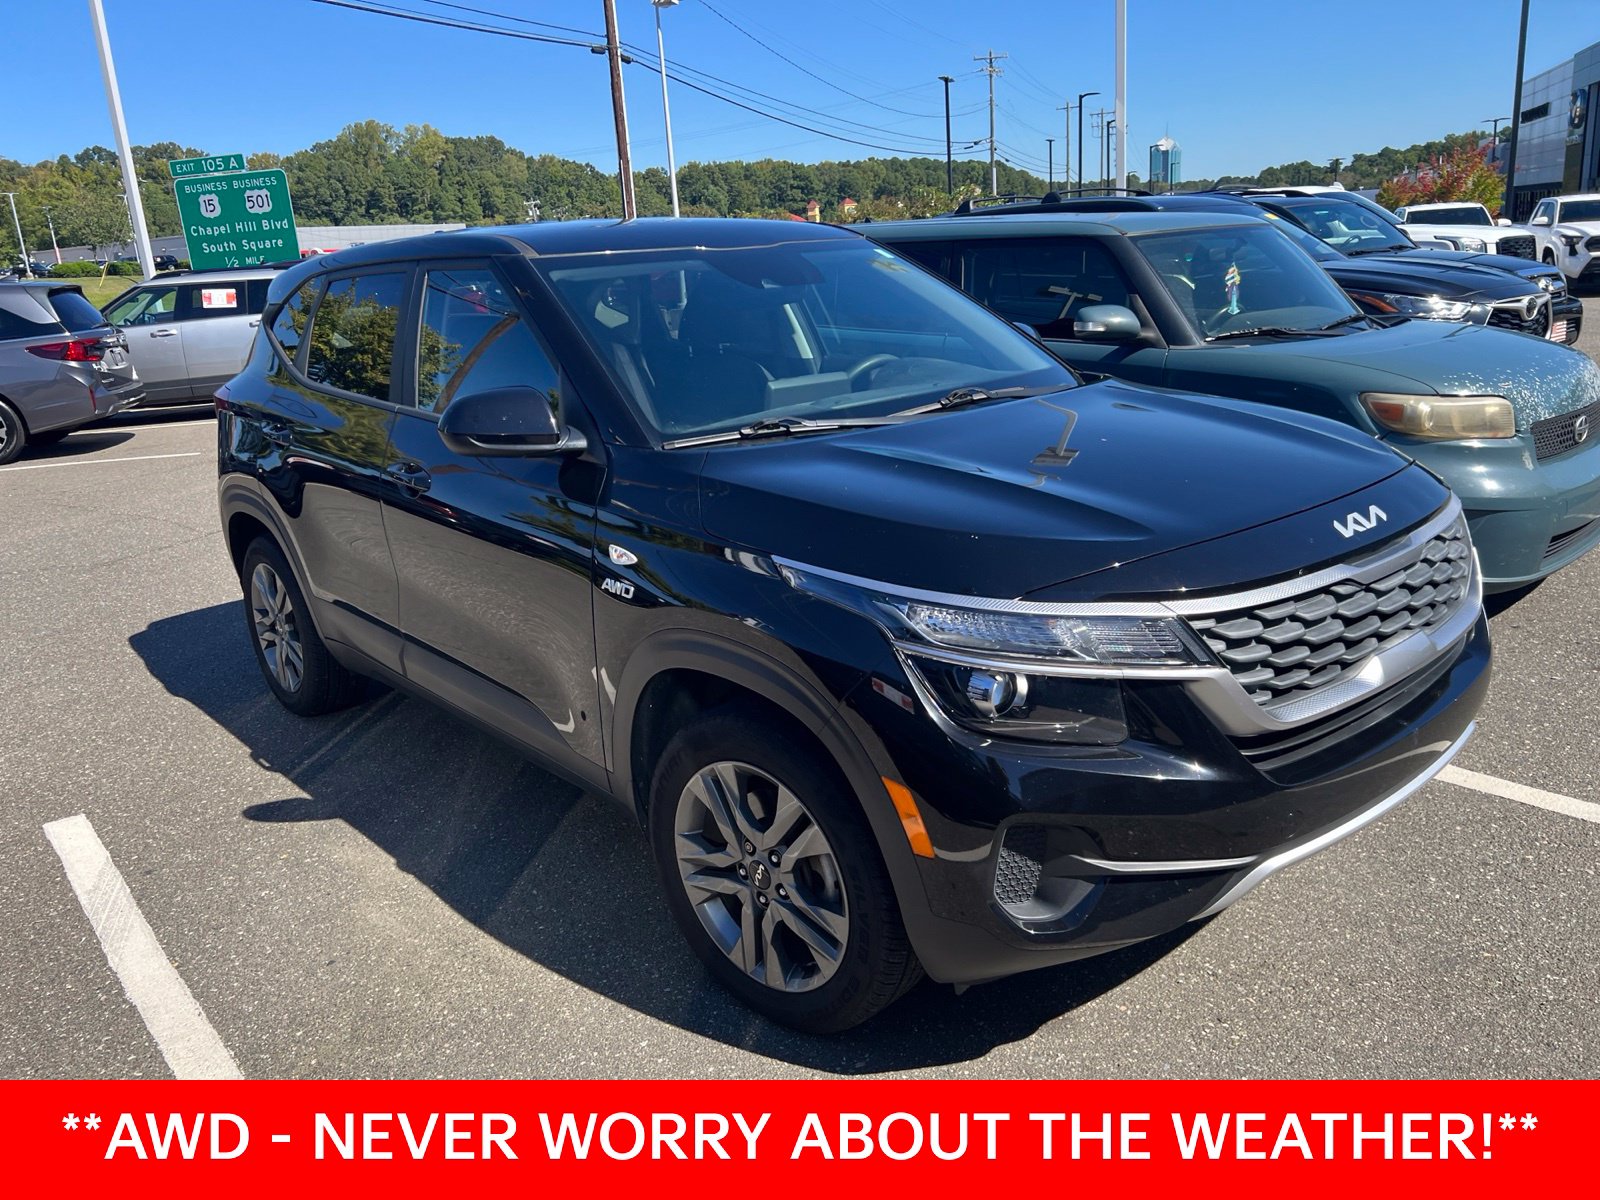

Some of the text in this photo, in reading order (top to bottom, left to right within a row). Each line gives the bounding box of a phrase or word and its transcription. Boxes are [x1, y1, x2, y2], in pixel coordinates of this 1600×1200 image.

[176, 157, 239, 173] EXIT 105 A
[185, 177, 277, 193] BUSINESS BUSINESS
[203, 194, 270, 213] 15 501
[190, 218, 289, 236] Chapel Hill Blvd
[201, 239, 283, 253] South Square
[1333, 504, 1387, 538] KIA
[601, 577, 635, 599] AWD
